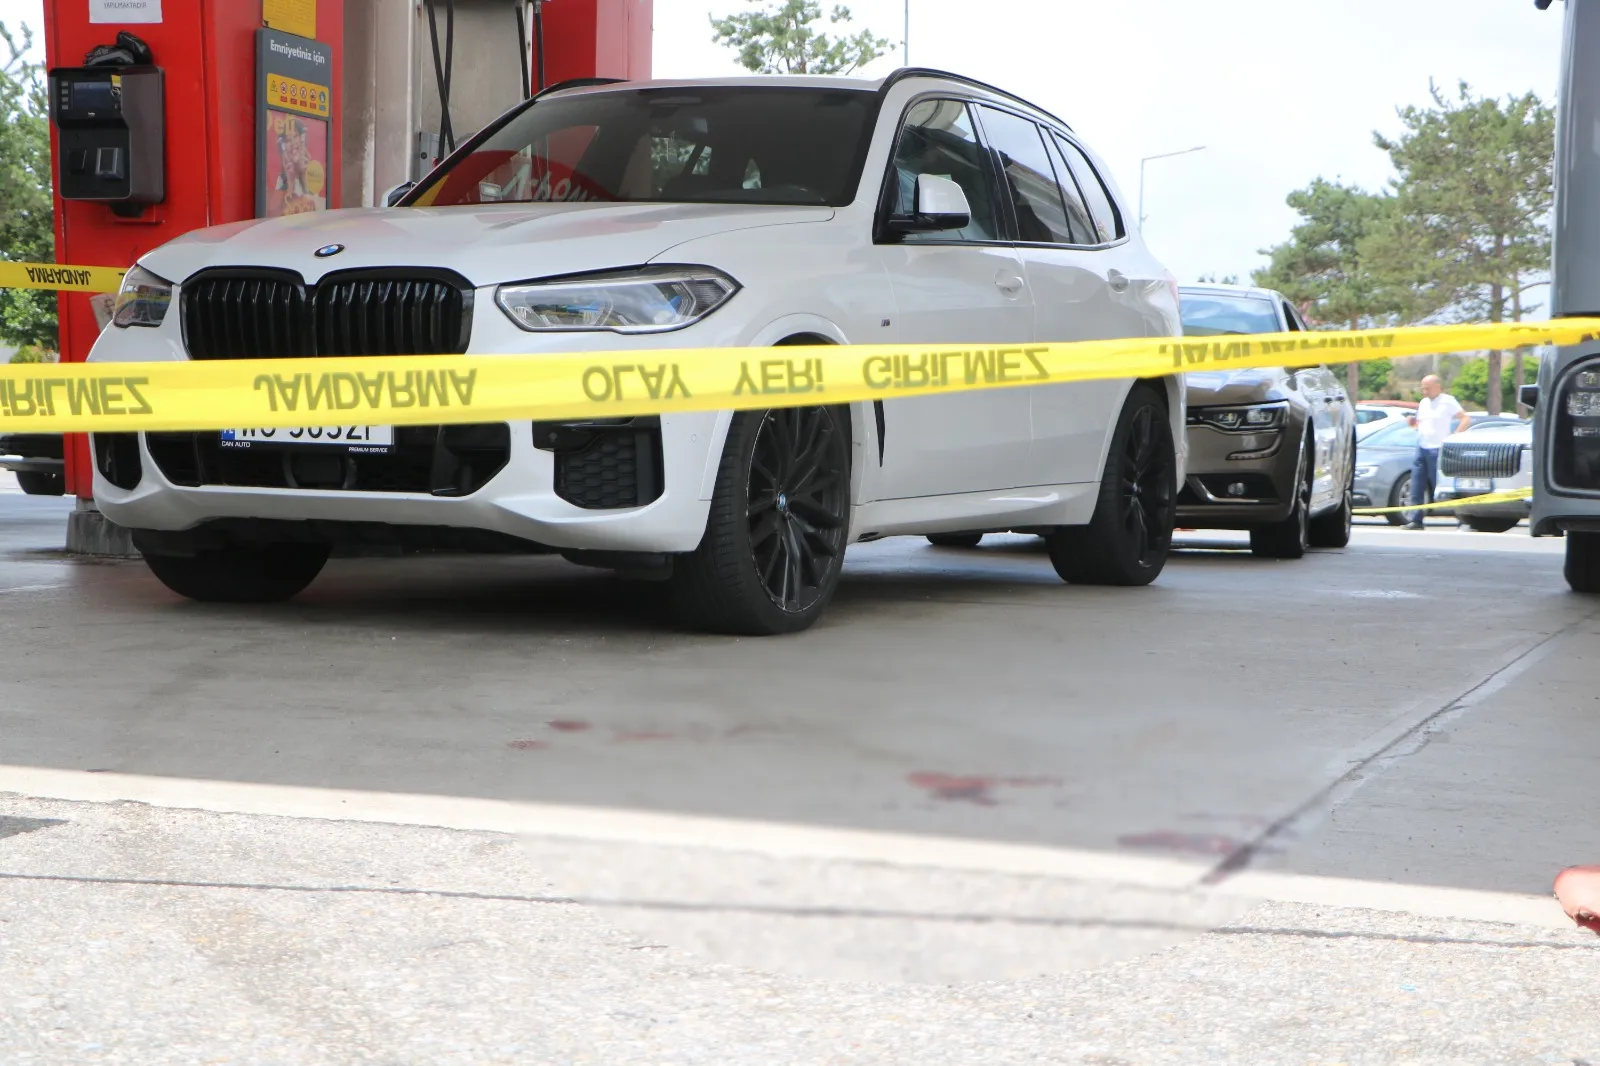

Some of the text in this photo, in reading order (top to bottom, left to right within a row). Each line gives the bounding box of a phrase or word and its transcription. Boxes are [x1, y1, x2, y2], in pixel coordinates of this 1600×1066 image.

[270, 39, 325, 65] Emniyetiniz için
[25, 266, 91, 285] JANDARMA
